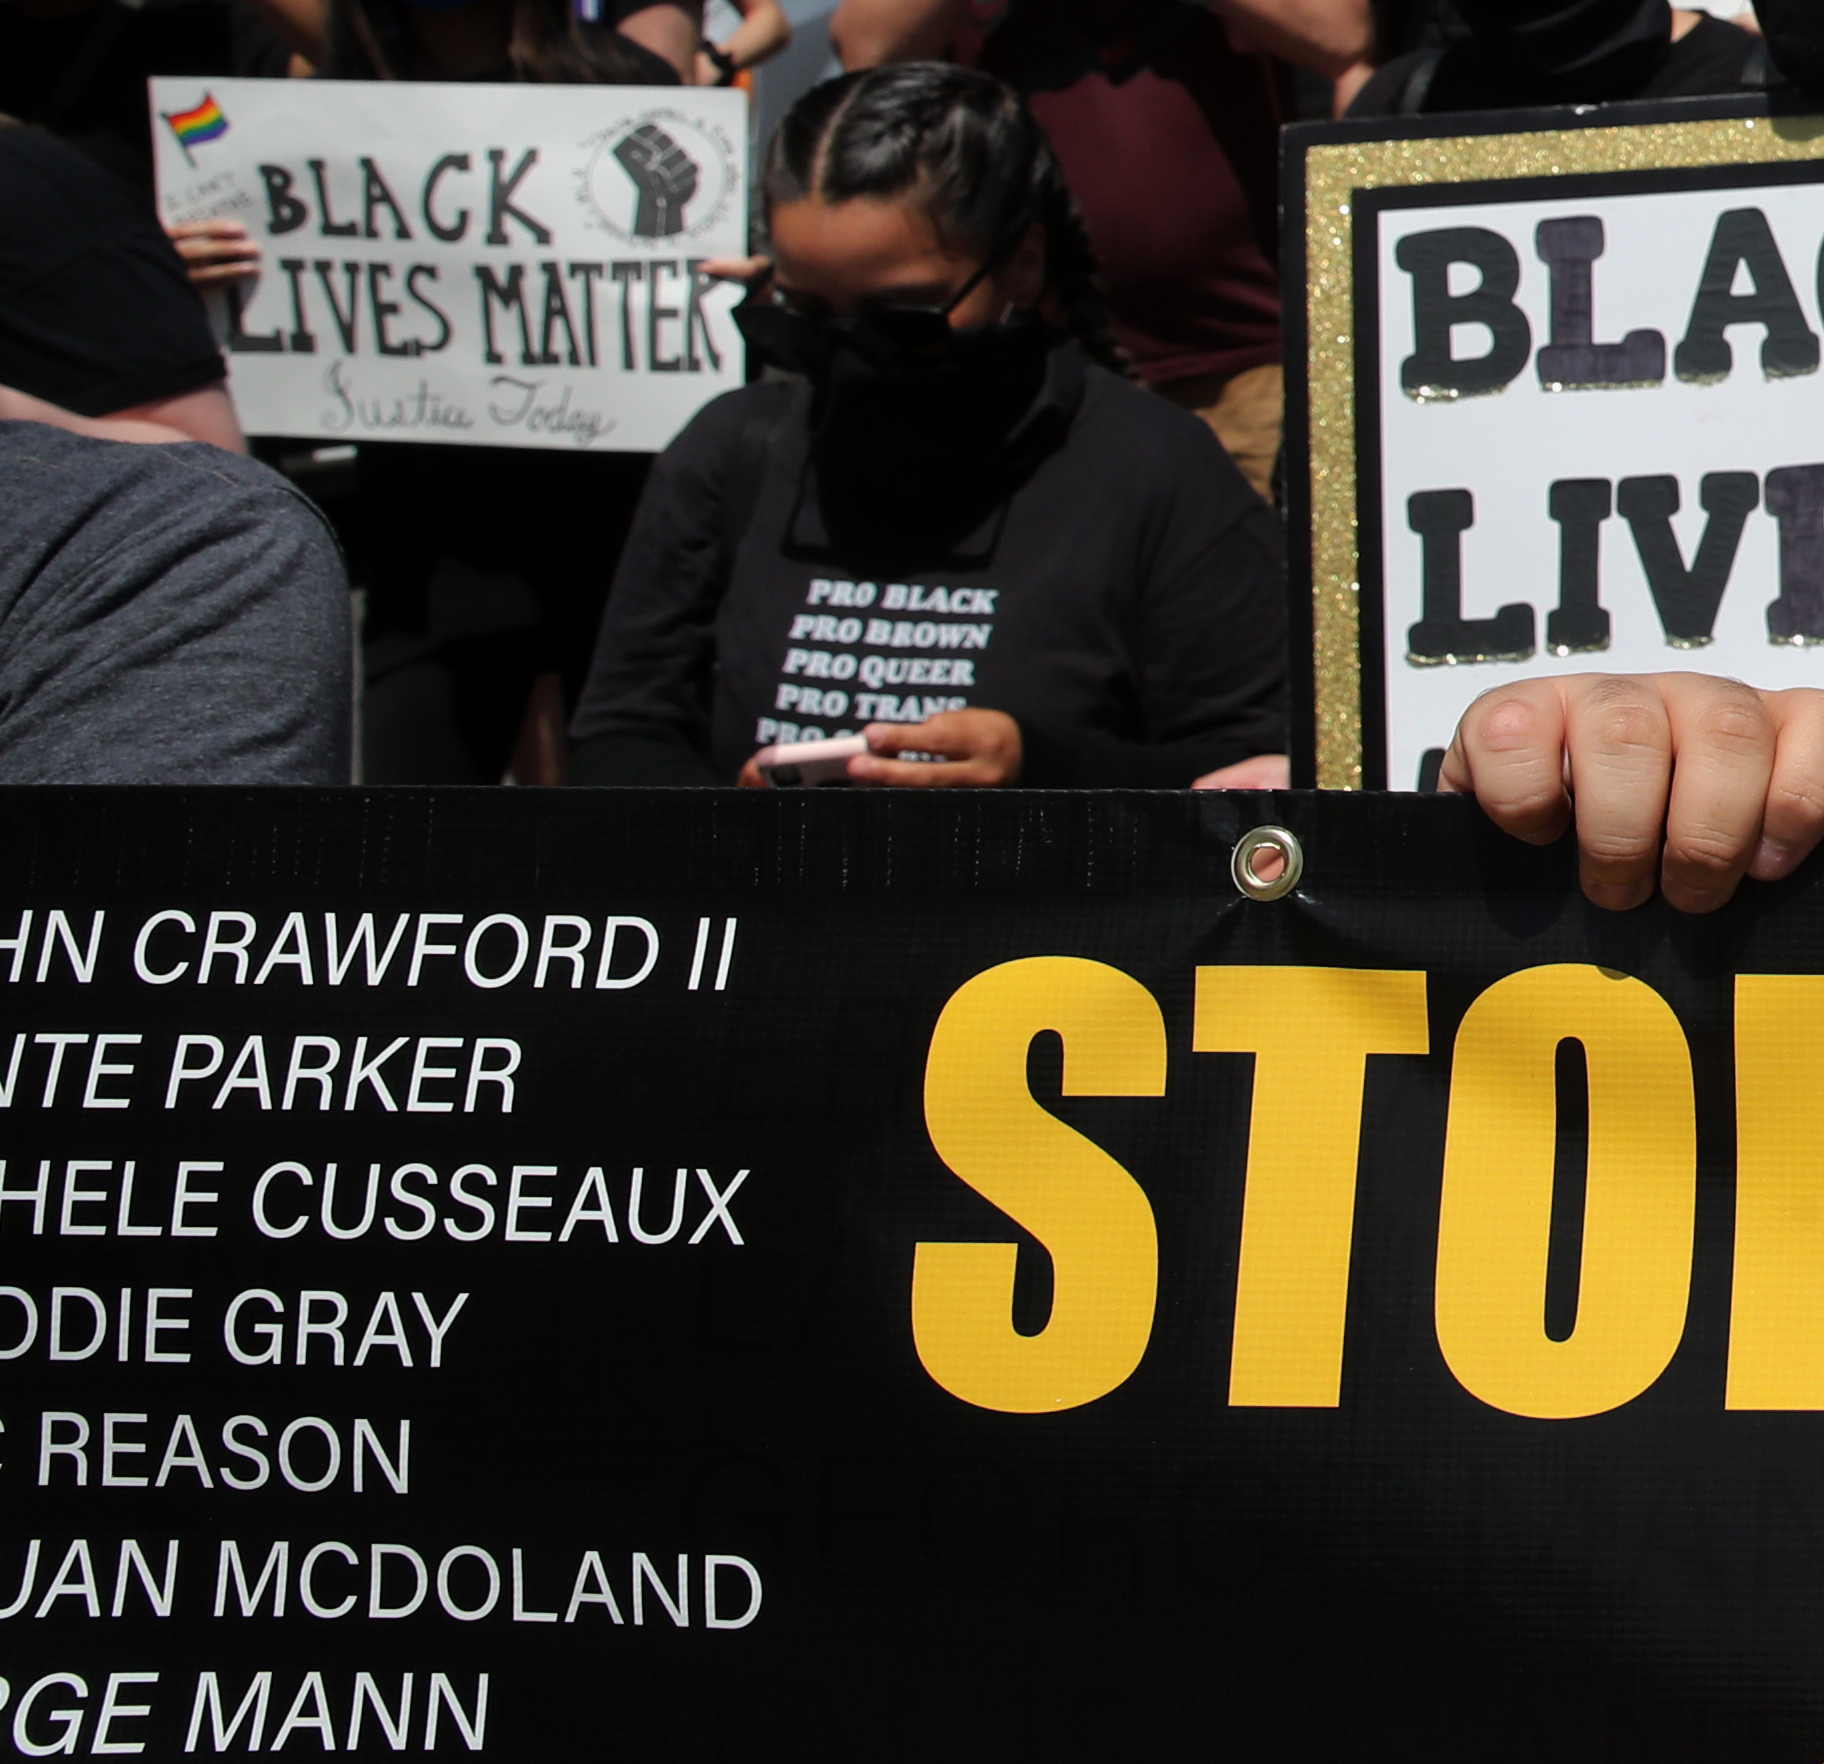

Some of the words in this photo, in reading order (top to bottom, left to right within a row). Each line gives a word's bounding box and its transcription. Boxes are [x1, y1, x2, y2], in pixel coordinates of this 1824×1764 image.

[258, 145, 554, 245] BLACK
[228, 258, 454, 359] LIVES
[474, 258, 723, 373] MATTER
[487, 375, 615, 449] Today
[789, 613, 863, 645] PRO
[864, 618, 993, 650] BROWN
[807, 577, 877, 608] PRO
[881, 583, 999, 615] BLACK
[776, 683, 849, 717] PRO
[782, 648, 857, 680] PRO
[858, 655, 975, 689] QUEER
[756, 717, 822, 744] PRO
[134, 910, 659, 989] CRAWFORD
[165, 1035, 521, 1112] PARKER
[253, 1162, 750, 1245] CUSSEAUX
[224, 1289, 469, 1367] GRAY
[39, 1412, 410, 1493] REASON
[214, 1541, 762, 1629] MCDOLAND
[185, 1672, 488, 1752] MANN
